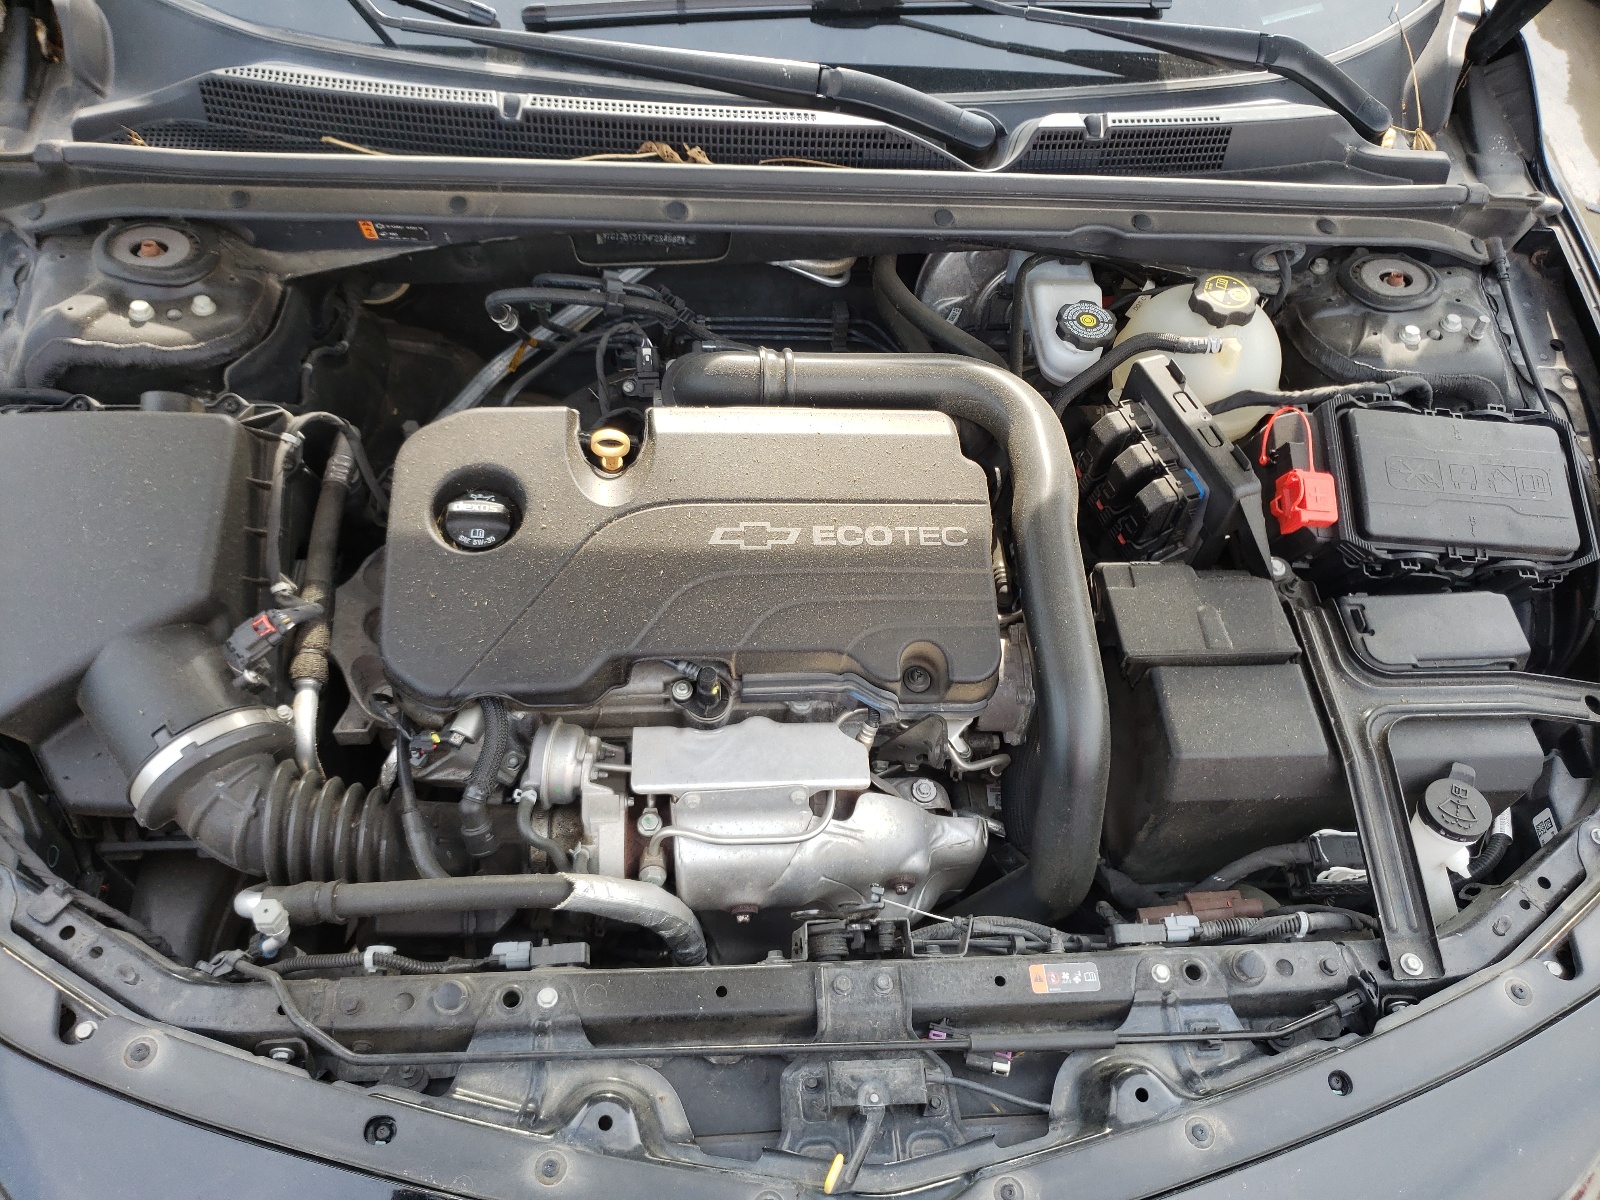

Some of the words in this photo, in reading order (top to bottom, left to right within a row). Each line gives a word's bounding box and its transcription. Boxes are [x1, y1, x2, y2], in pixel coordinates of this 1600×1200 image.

[453, 502, 498, 512] dexos
[459, 534, 472, 544] SAE
[472, 535, 496, 546] 5W-30
[812, 525, 969, 546] ECOTEC
